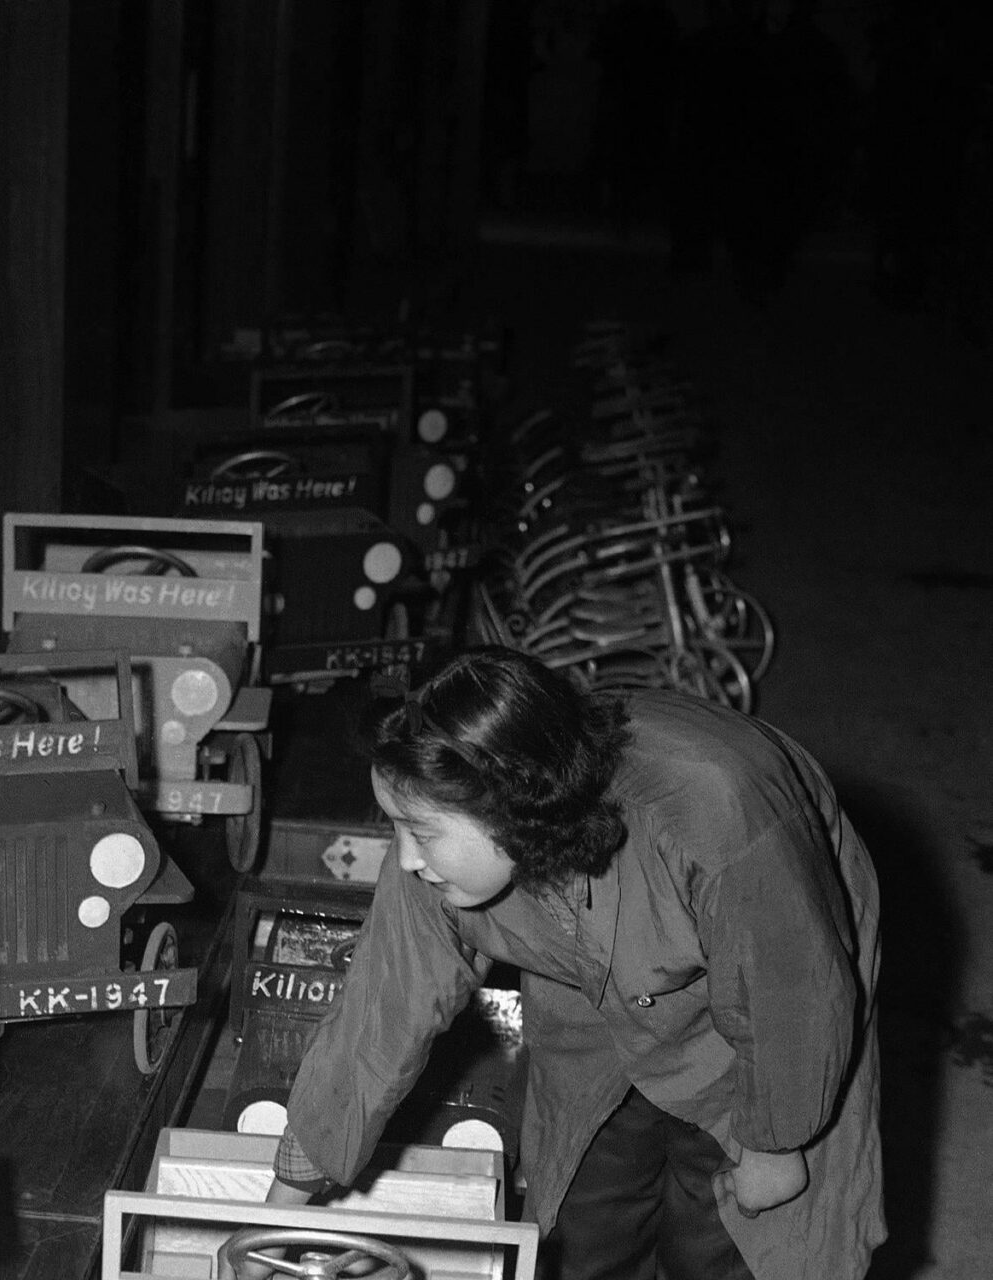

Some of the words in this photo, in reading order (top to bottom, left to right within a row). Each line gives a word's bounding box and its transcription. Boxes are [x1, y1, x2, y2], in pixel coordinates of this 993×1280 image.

[251, 478, 292, 501] Was
[22, 576, 98, 611] Kilroy
[105, 578, 154, 605] Was
[18, 977, 171, 1017] KK-1947
